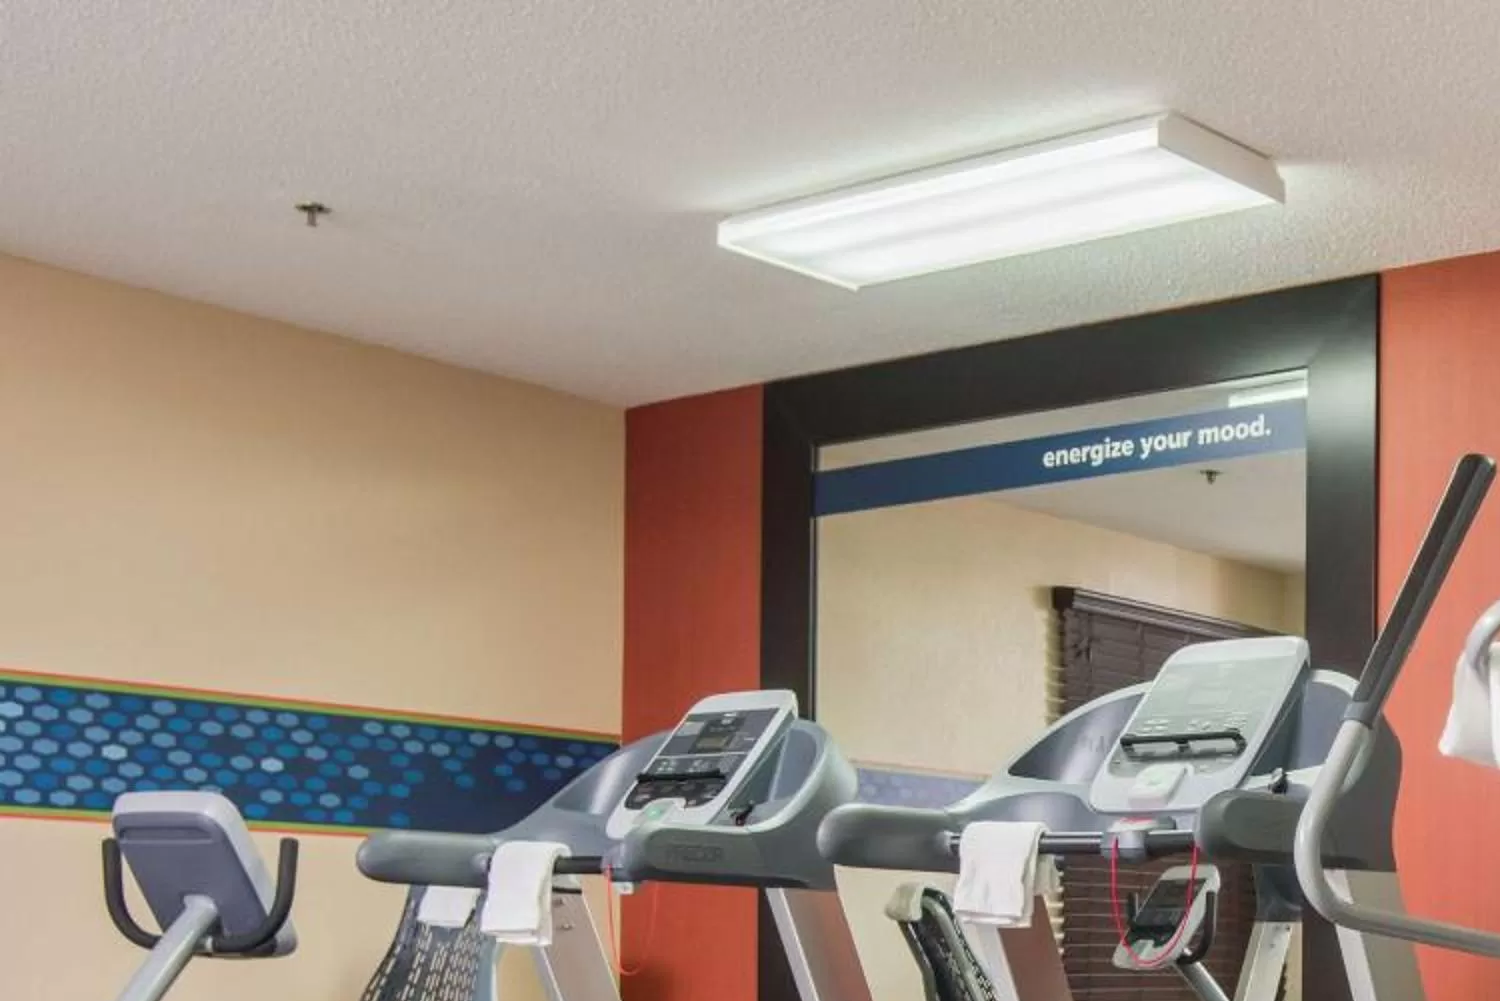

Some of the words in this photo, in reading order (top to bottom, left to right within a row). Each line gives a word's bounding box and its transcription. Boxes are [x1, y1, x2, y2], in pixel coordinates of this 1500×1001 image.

[1042, 436, 1134, 468] energize
[1139, 428, 1193, 460] your
[1197, 413, 1272, 446] mood.
